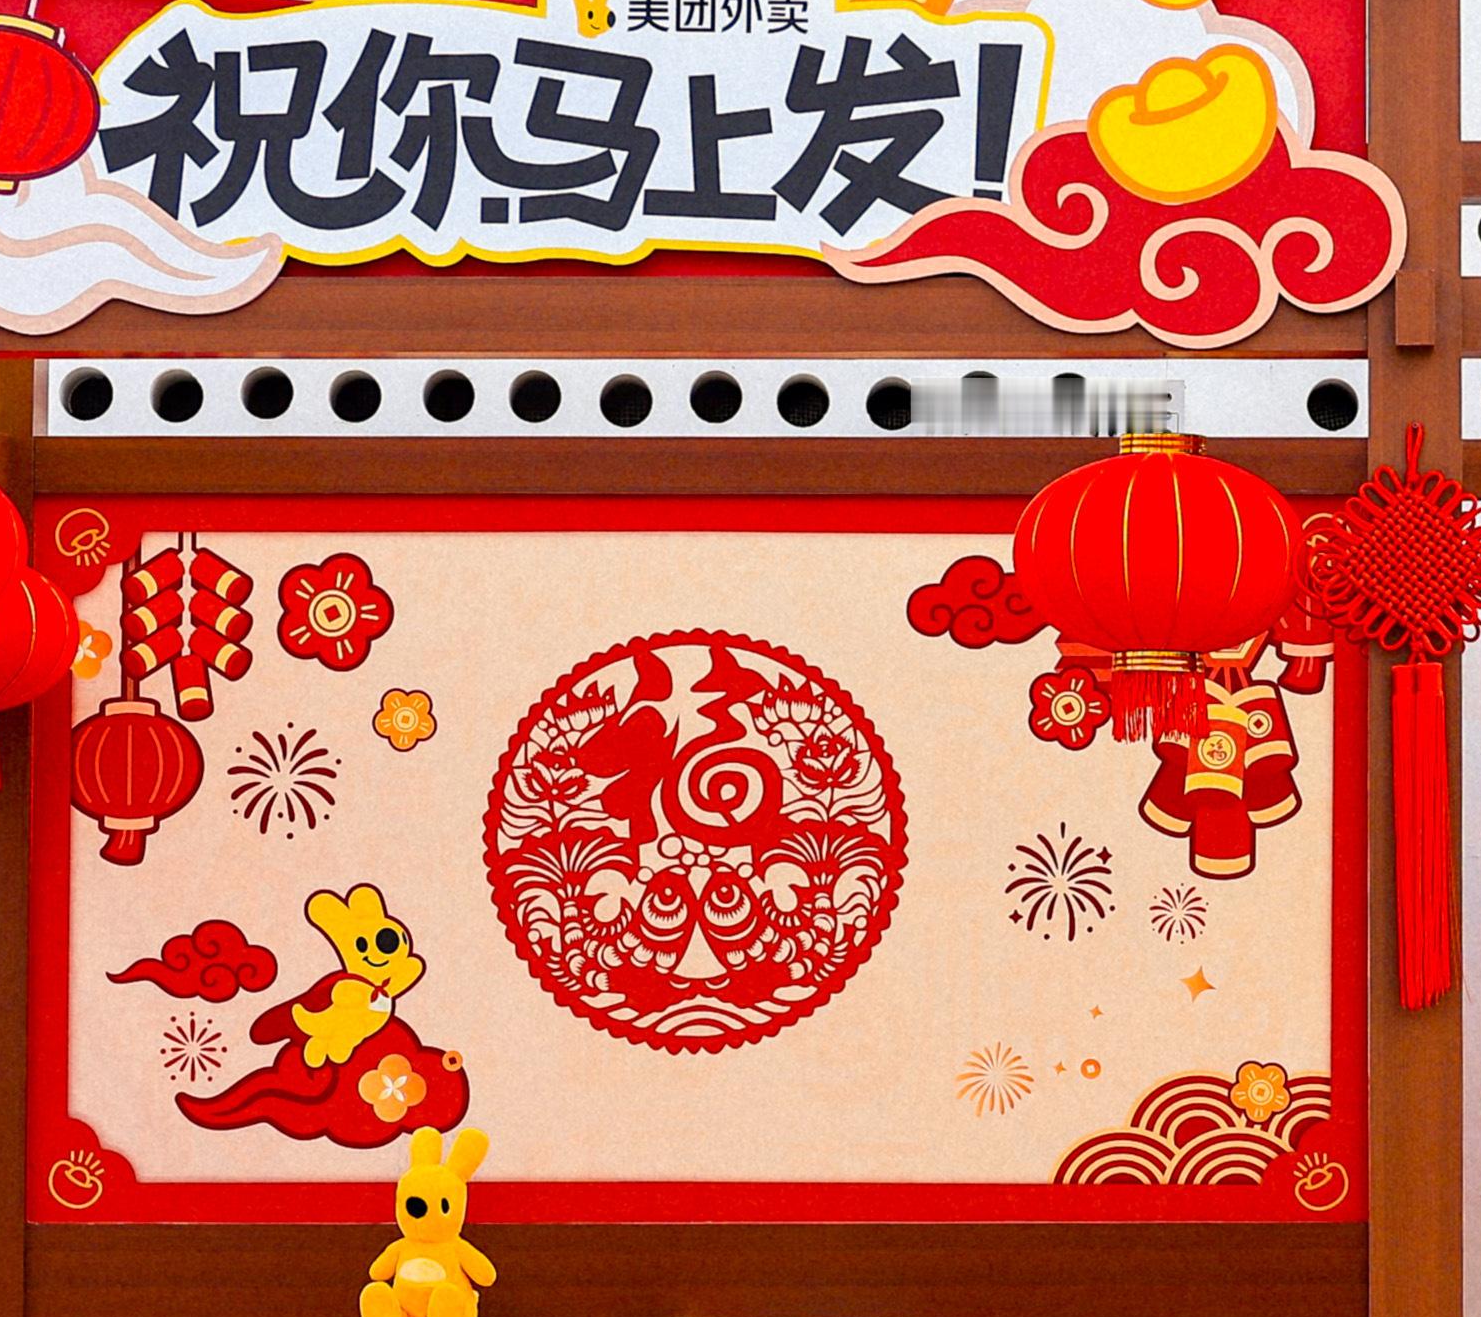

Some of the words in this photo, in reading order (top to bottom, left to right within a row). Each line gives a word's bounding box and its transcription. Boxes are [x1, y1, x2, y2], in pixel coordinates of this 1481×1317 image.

[99, 26, 1022, 237] 祝你马上发!
